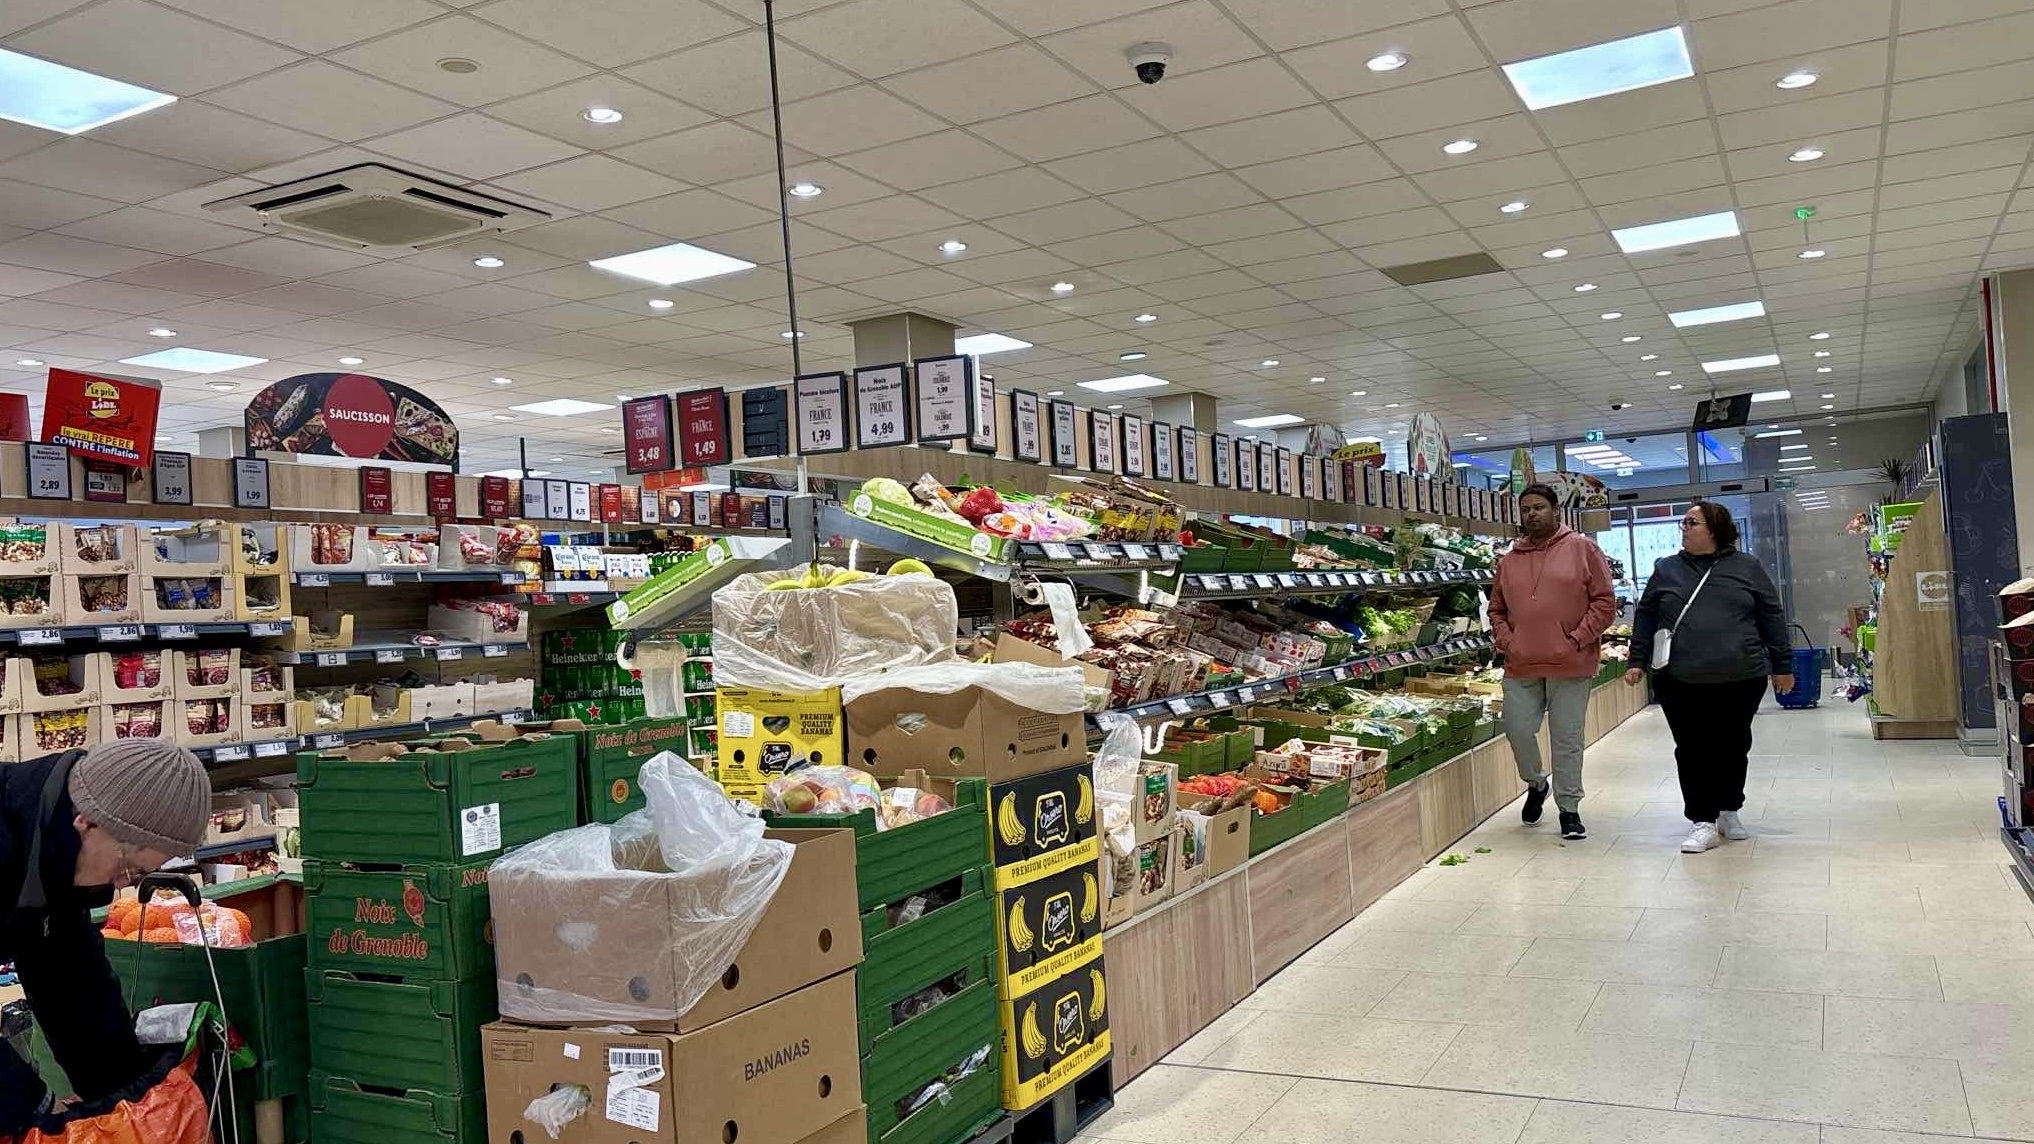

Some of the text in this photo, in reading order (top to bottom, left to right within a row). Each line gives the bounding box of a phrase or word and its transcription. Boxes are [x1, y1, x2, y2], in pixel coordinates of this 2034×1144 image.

[100, 388, 115, 397] prix
[329, 408, 390, 424] SAUCISSON
[809, 408, 832, 422] FRANCE
[63, 427, 71, 436] le
[72, 430, 90, 440] vrai
[871, 422, 894, 436] 4,99
[52, 435, 139, 460] CONTRE l'inflation
[638, 446, 660, 462] 3,48
[693, 440, 716, 456] 1,49
[1352, 446, 1374, 458] prix
[40, 480, 60, 490] 2,89
[165, 486, 182, 496] 3,99
[41, 630, 59, 639] 2,86
[120, 626, 137, 635] 2,86
[800, 713, 834, 721] PREMIUM
[1011, 843, 1091, 878] PREMIUM QUALITY BANANAS
[461, 866, 490, 889] Noi
[354, 898, 396, 924] Noix
[328, 928, 430, 960] de Grenoble
[1021, 943, 1095, 985] PREMIUM QUALITY BANANAS
[744, 1038, 810, 1082] BANANAS
[1035, 1041, 1104, 1091] PREMIUM QUALITY BANANAS
